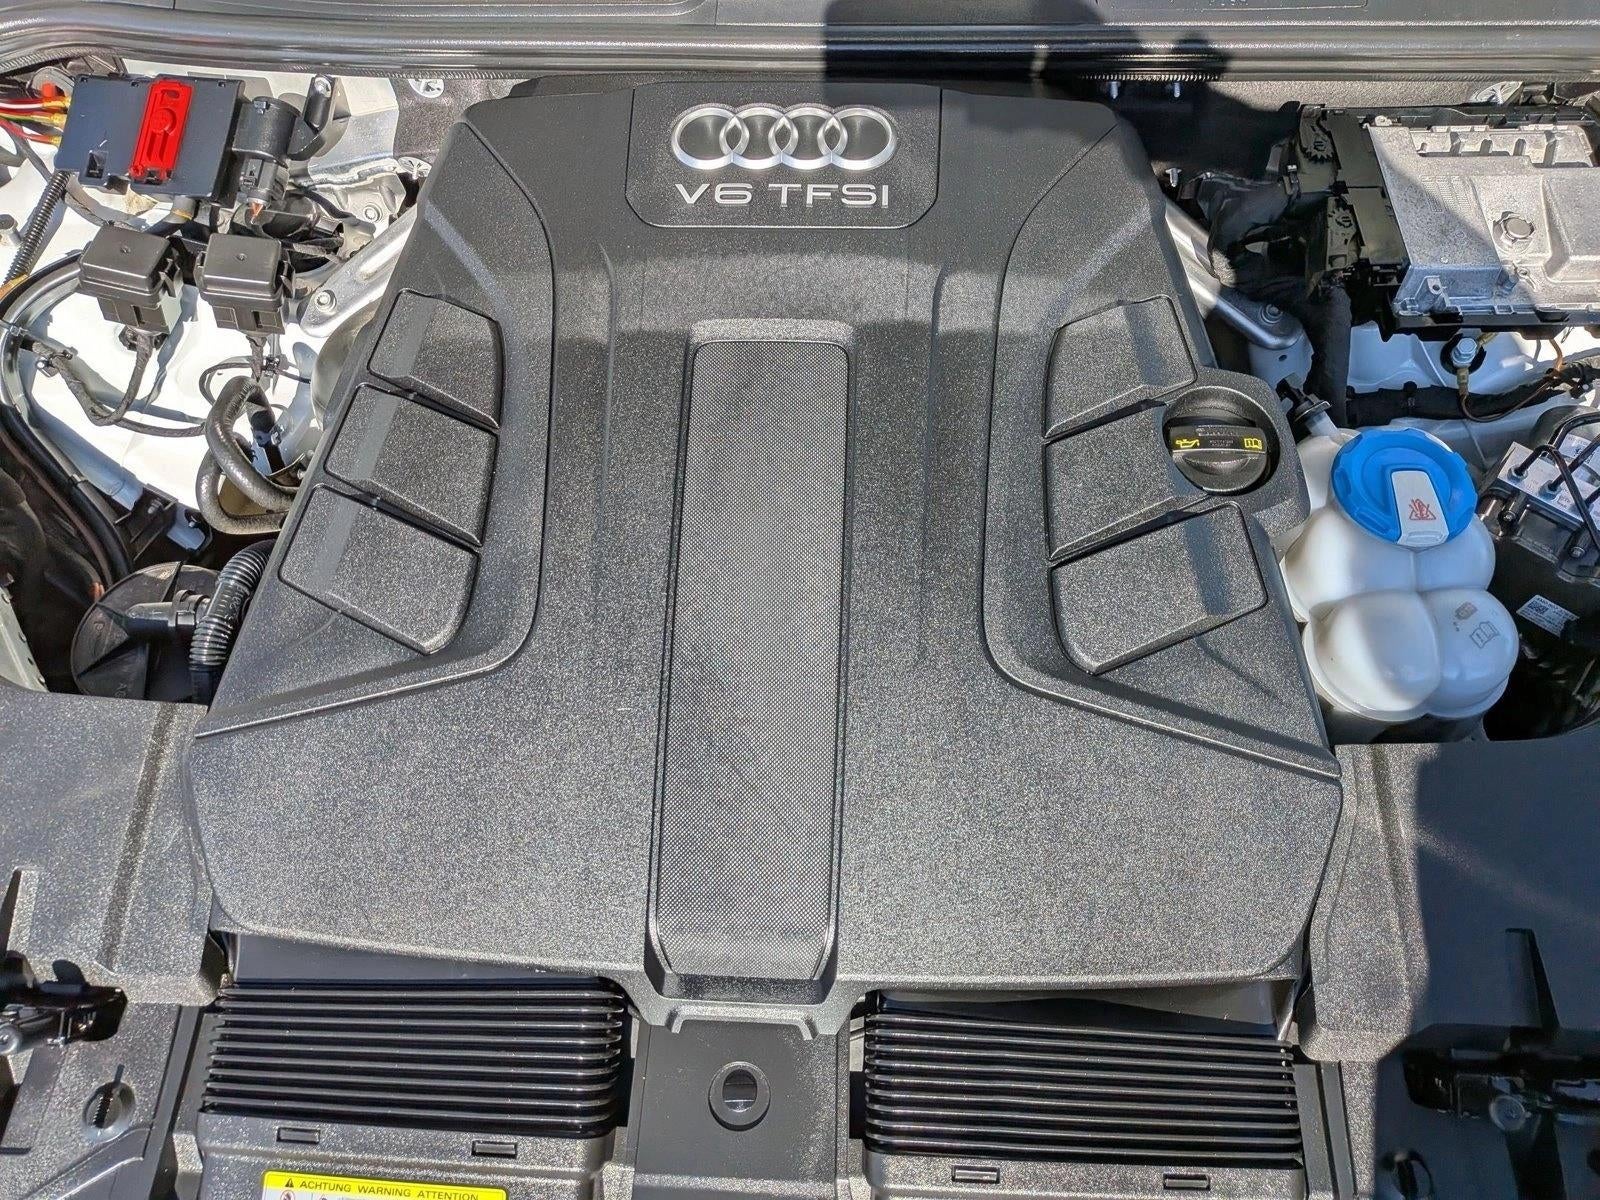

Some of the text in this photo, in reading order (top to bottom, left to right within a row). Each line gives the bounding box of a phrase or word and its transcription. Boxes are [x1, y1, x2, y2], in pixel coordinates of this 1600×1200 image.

[674, 182, 889, 207] V6 TFSI
[300, 1180, 479, 1200] ACHTUNG WARNING ATTENTION
